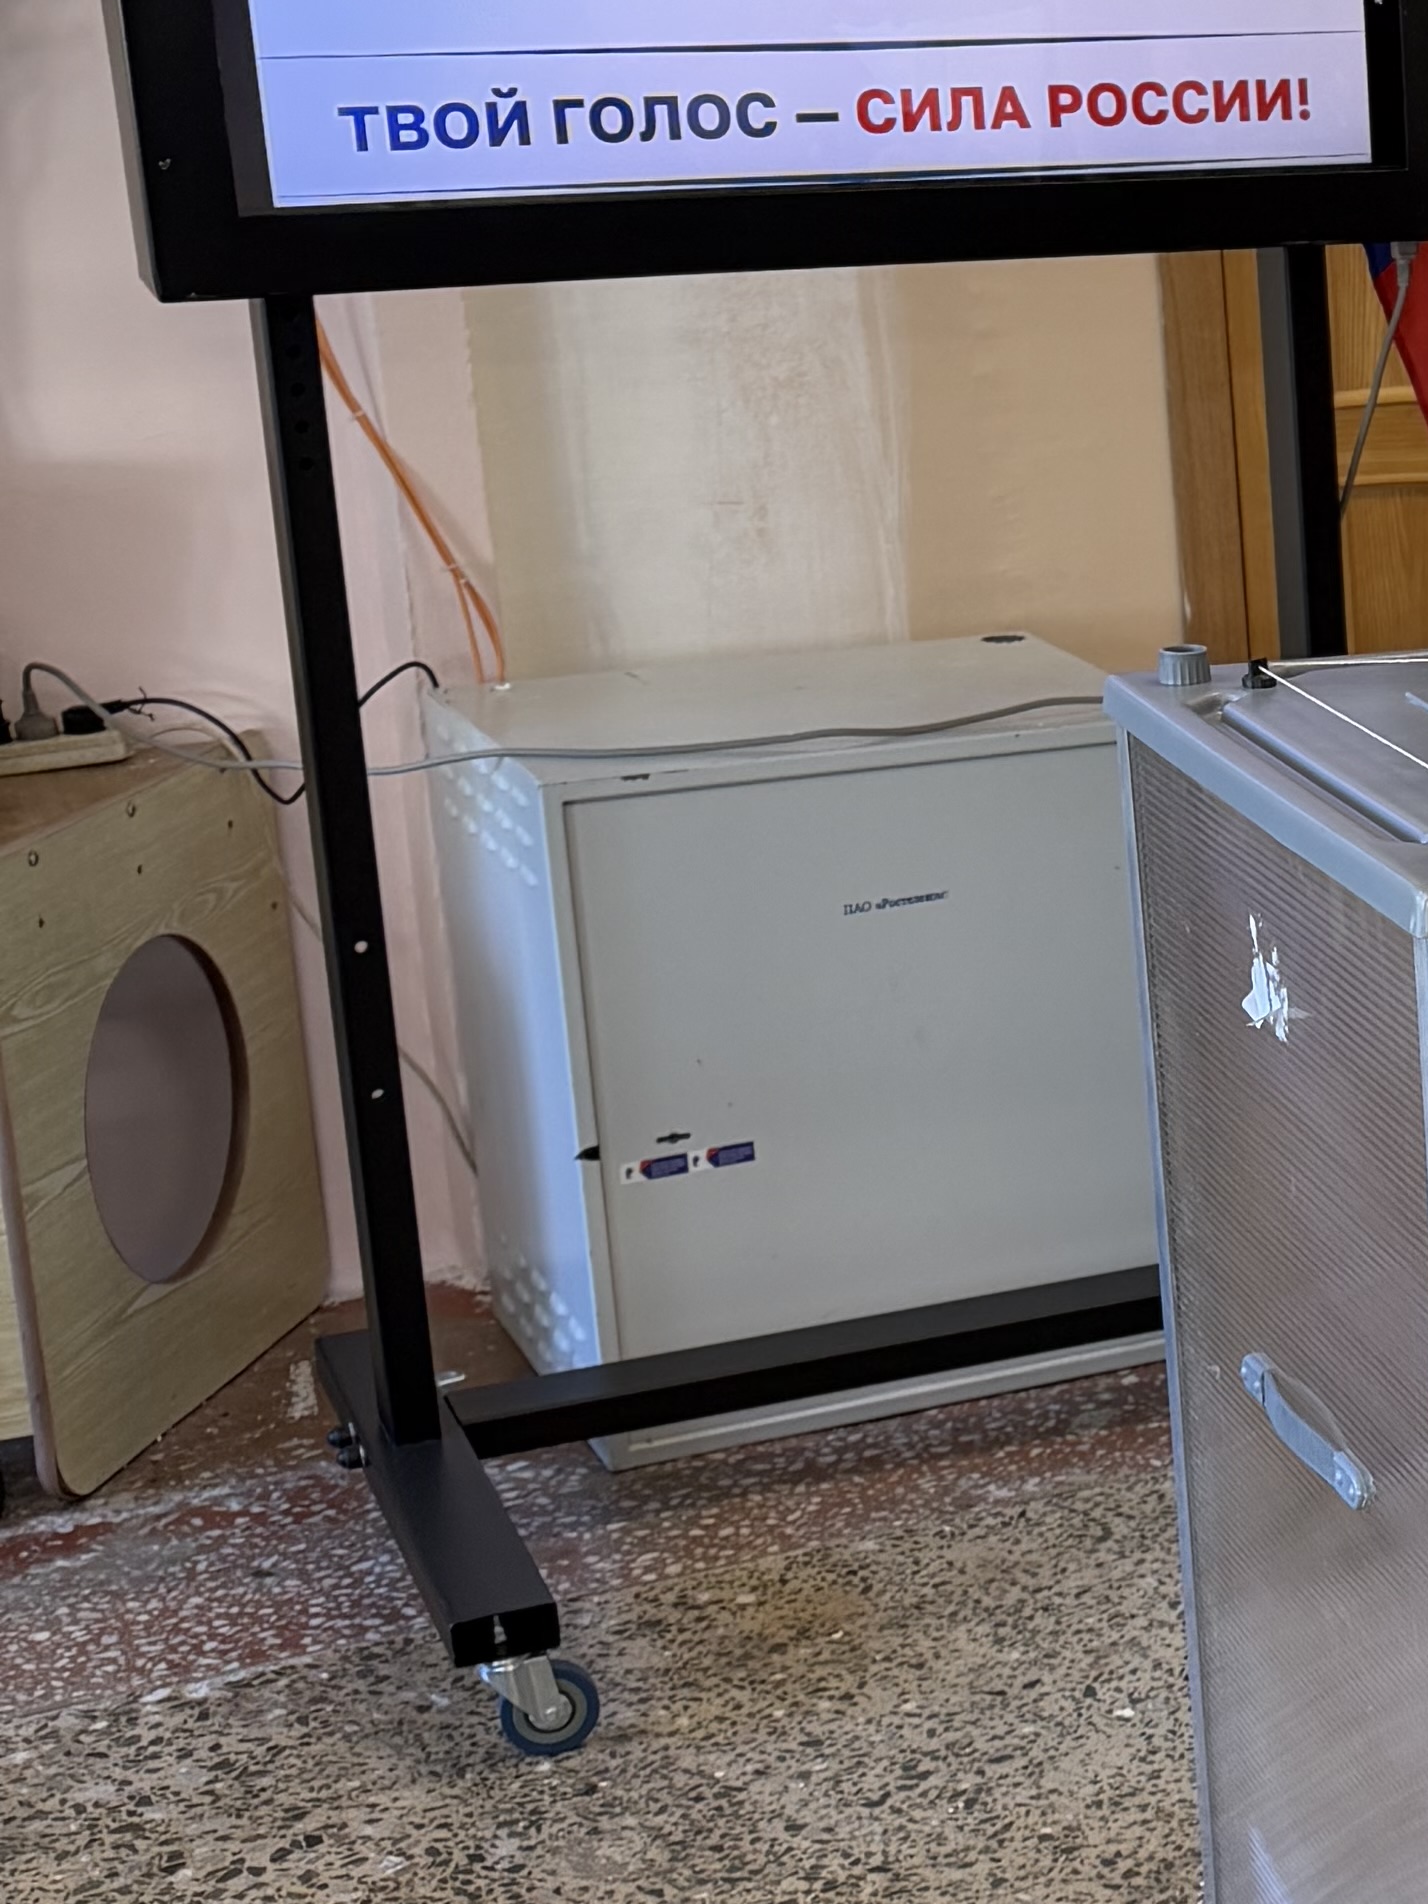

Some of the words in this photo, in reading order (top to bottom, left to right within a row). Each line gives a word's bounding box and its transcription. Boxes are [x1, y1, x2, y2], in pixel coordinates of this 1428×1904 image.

[337, 87, 531, 152] ТВОЙ
[553, 92, 778, 145] ГОЛОС
[856, 86, 1031, 134] СИЛА
[1047, 77, 1311, 128] РОССИИ!
[843, 900, 873, 916] ПАО
